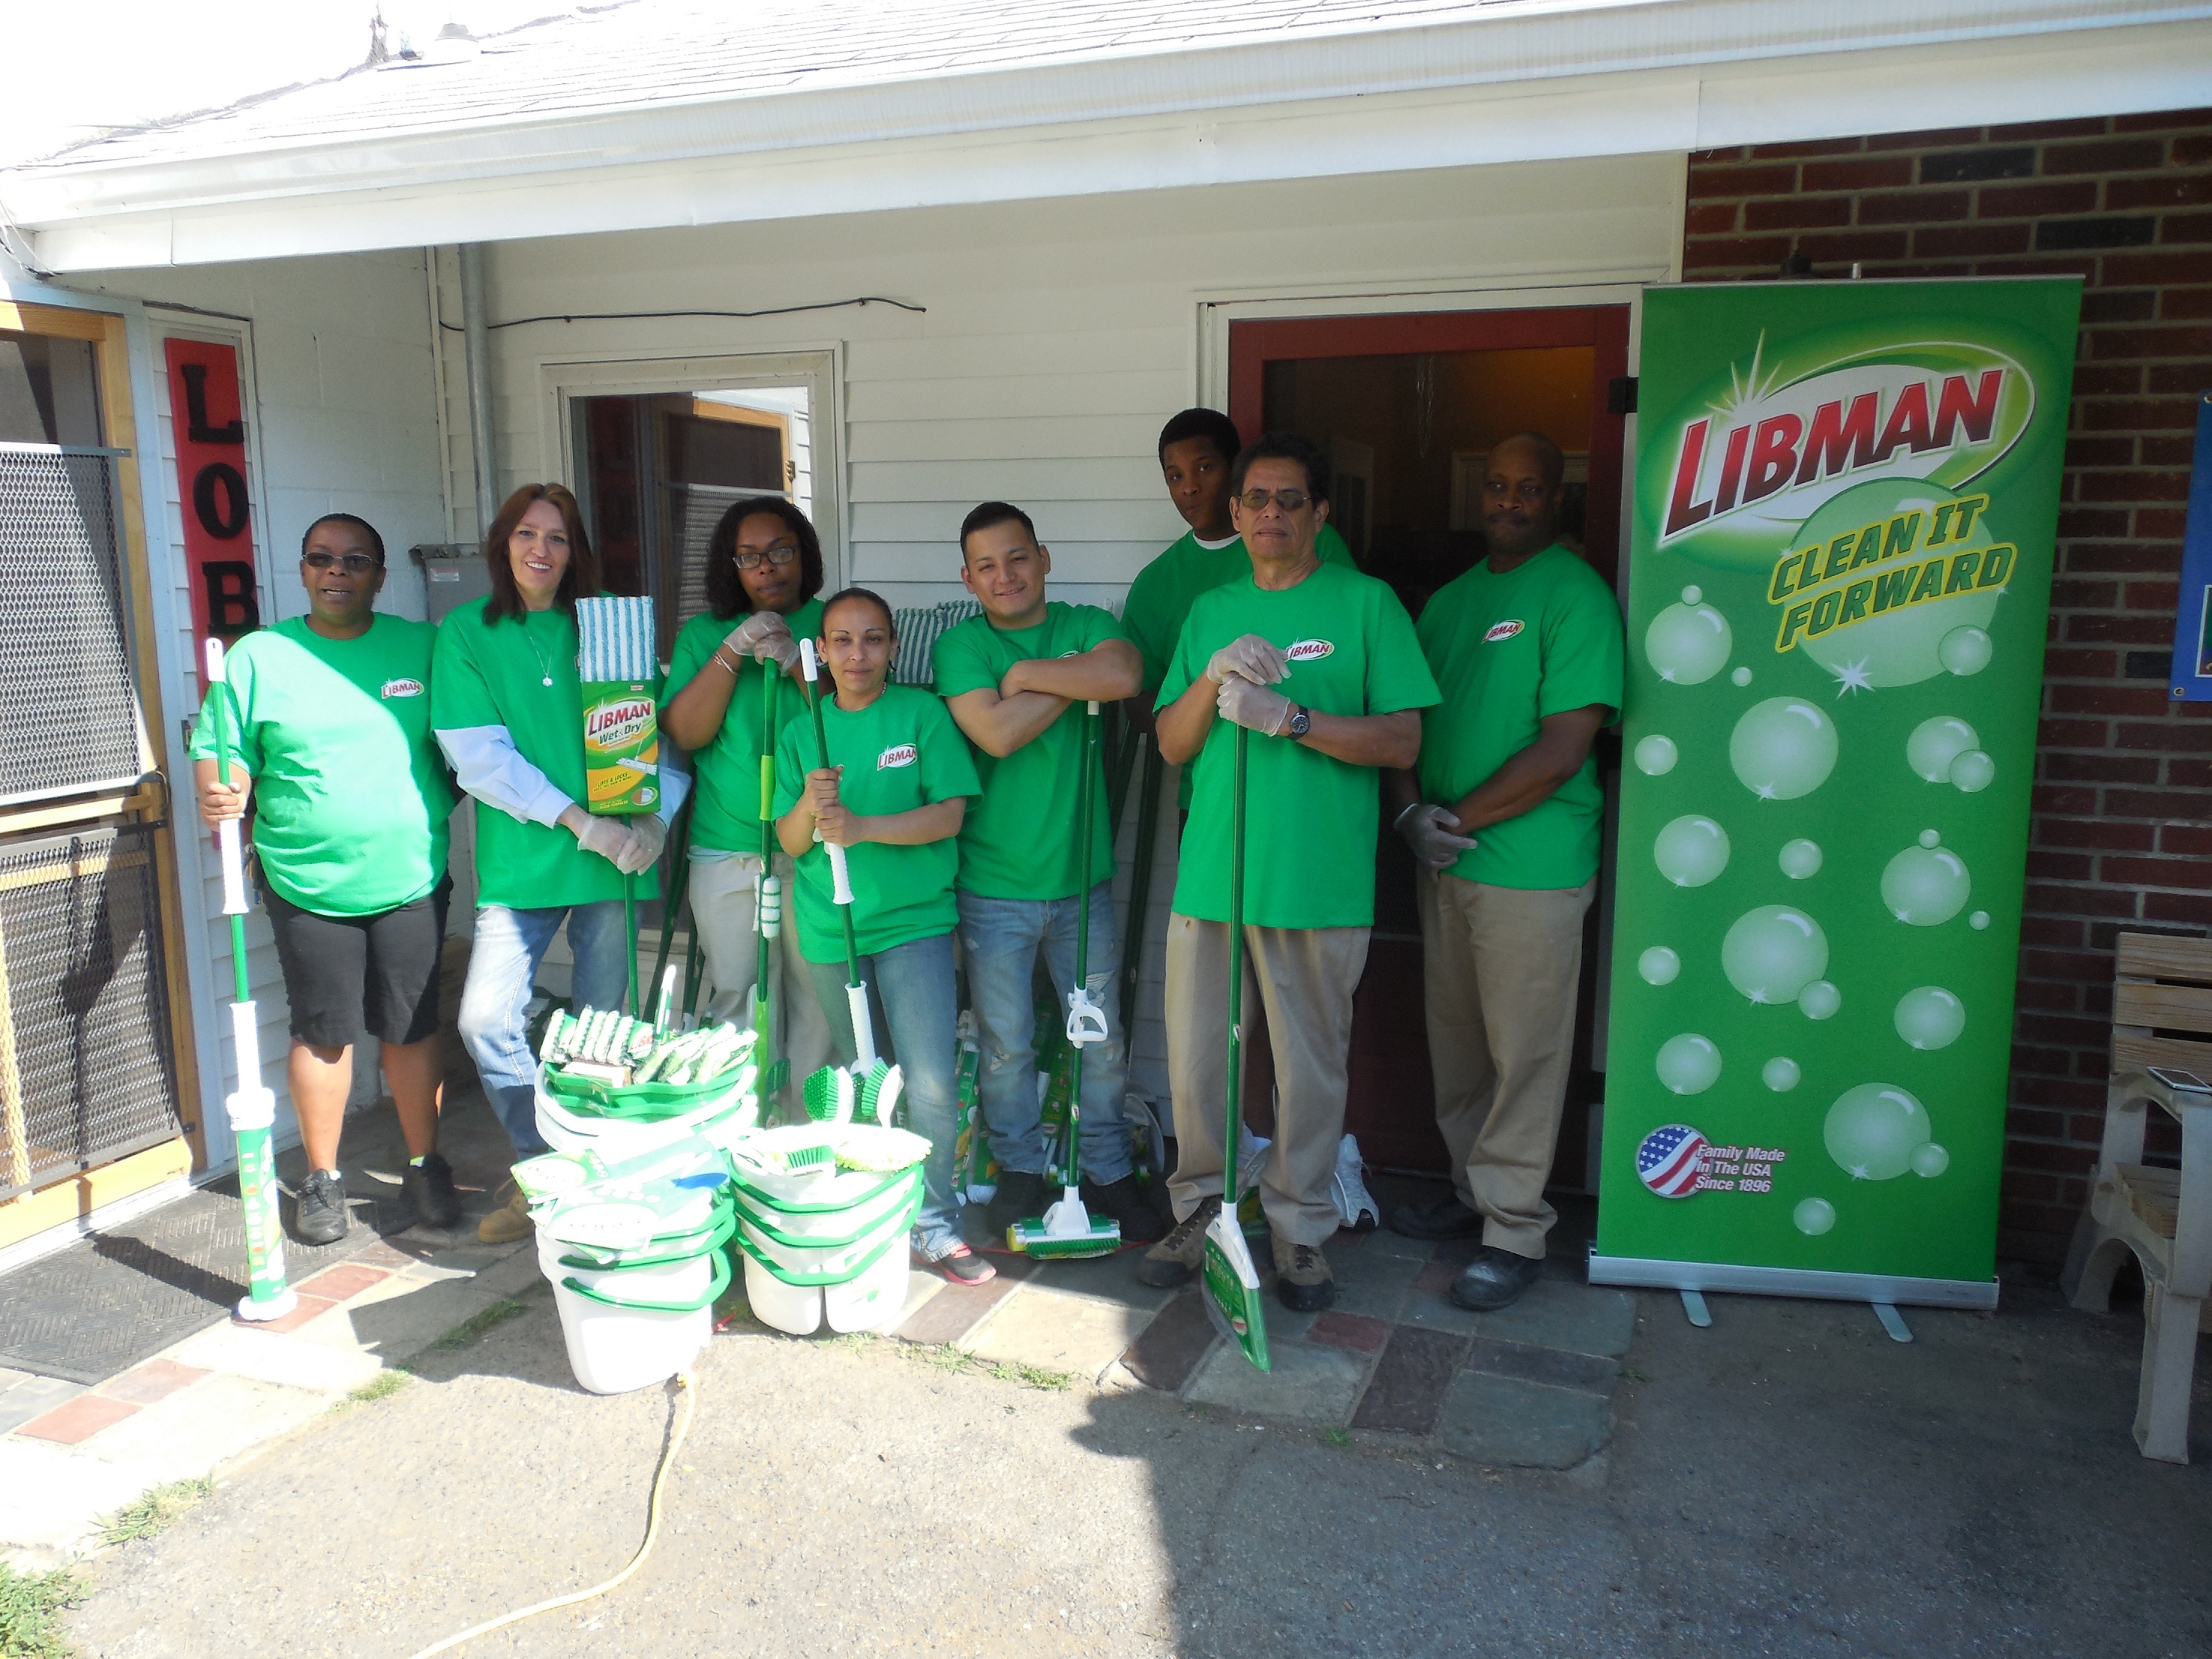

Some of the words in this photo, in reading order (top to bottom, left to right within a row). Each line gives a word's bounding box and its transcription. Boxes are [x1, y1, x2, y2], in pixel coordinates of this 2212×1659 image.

[1664, 368, 2004, 538] LIBMAN
[1769, 511, 1923, 603] CLEAN
[1924, 495, 1987, 549] IT
[1777, 545, 2016, 651] FORWARD
[1482, 622, 1521, 642] LIBMAN
[382, 682, 421, 698] LIBMAN
[588, 701, 651, 736] LIBMAN
[599, 730, 619, 744] Wet
[624, 722, 642, 735] Dry
[1697, 1144, 1743, 1161] Family
[1745, 1147, 1785, 1162] Made
[1695, 1160, 1710, 1174] In
[1714, 1161, 1739, 1175] The
[1743, 1162, 1771, 1177] USA
[1695, 1175, 1734, 1190] Since
[1738, 1178, 1772, 1193] 1896
